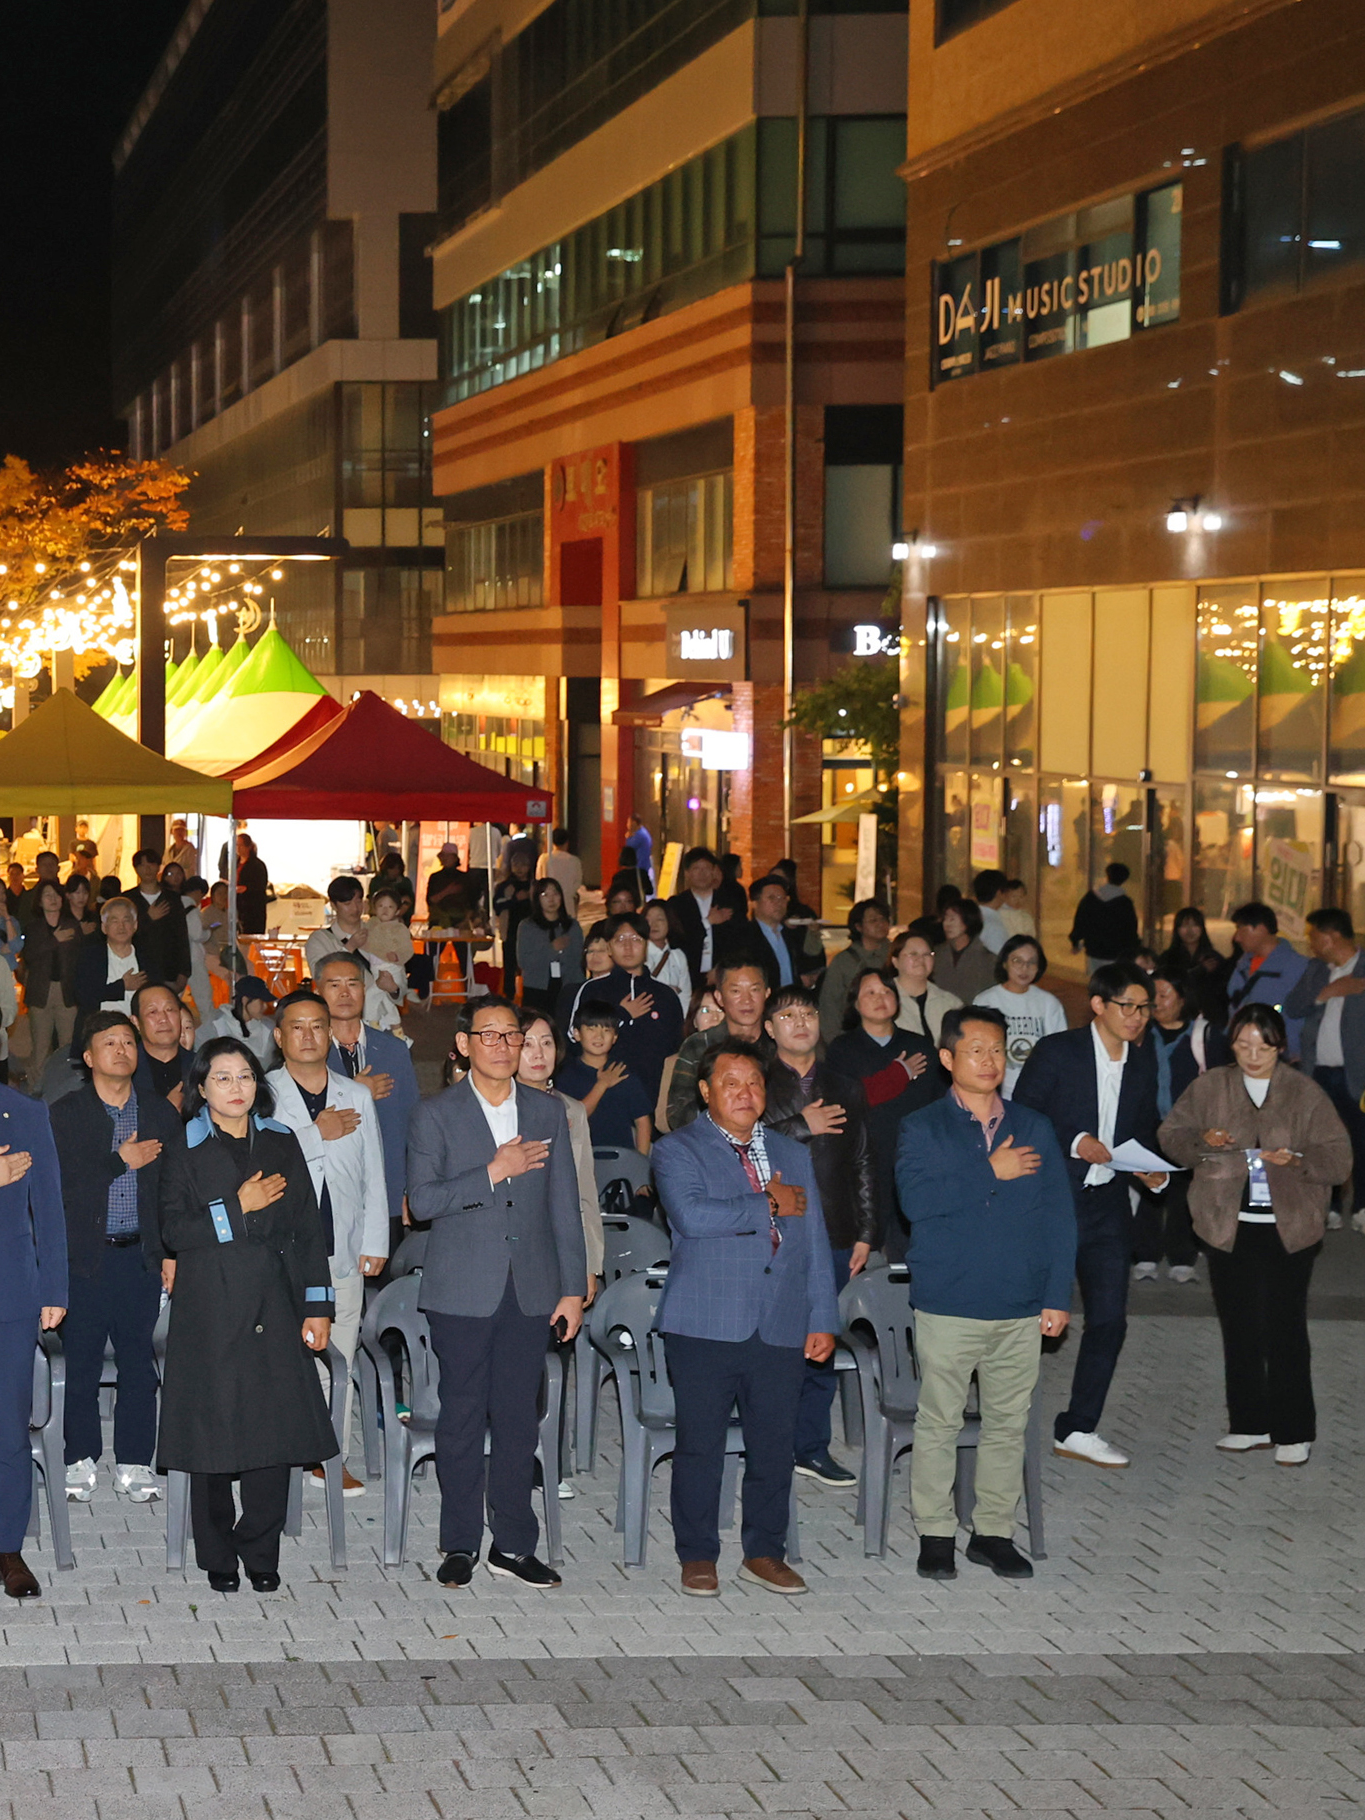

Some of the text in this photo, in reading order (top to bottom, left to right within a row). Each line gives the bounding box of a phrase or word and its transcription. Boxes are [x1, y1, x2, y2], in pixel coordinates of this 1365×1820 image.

[938, 276, 1001, 346] DAJI
[1007, 275, 1074, 324] MUSIC
[1078, 248, 1162, 304] STUDIO
[681, 628, 717, 660] Behind
[718, 629, 733, 660] U
[1268, 856, 1308, 918] 임대
